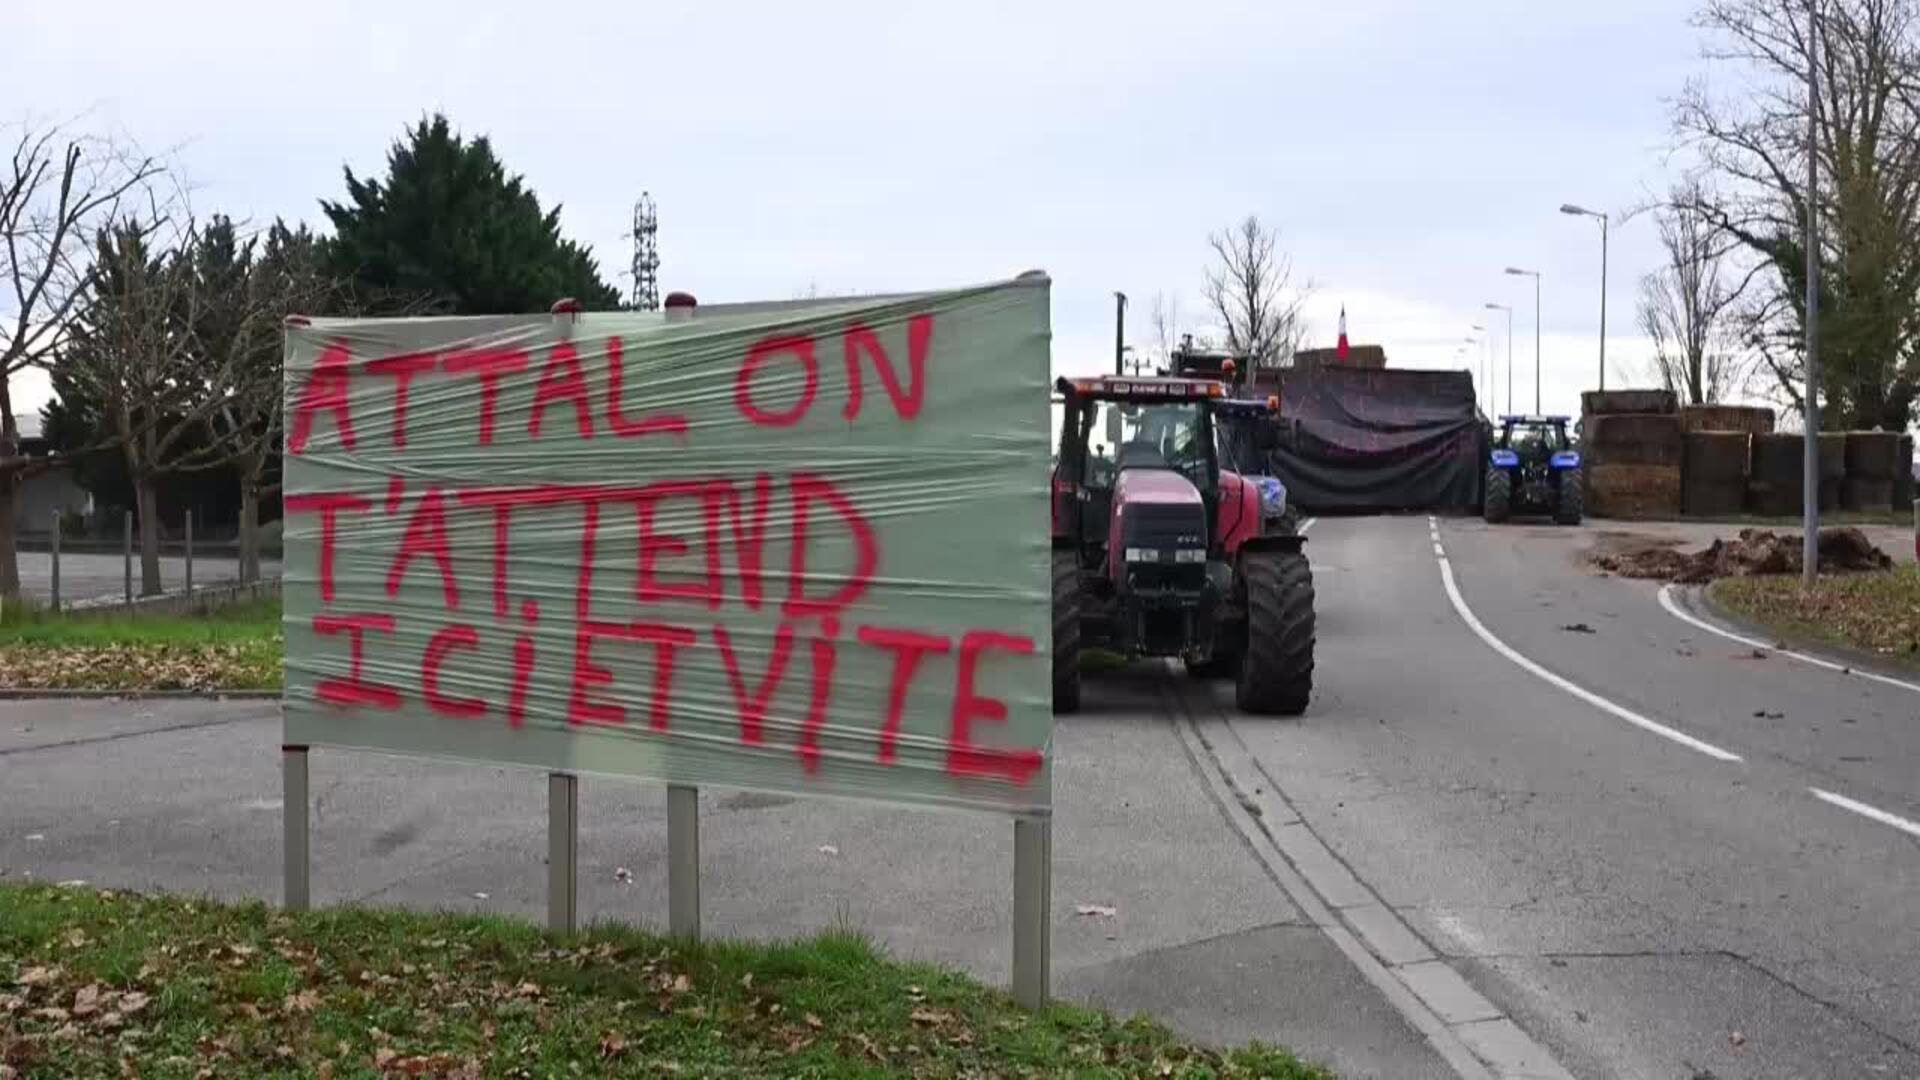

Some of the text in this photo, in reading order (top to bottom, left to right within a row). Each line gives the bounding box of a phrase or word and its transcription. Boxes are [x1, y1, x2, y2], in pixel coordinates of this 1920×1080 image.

[288, 314, 933, 455] ATTAL ON
[284, 473, 879, 621] T'ATTEND
[570, 620, 696, 732] ET
